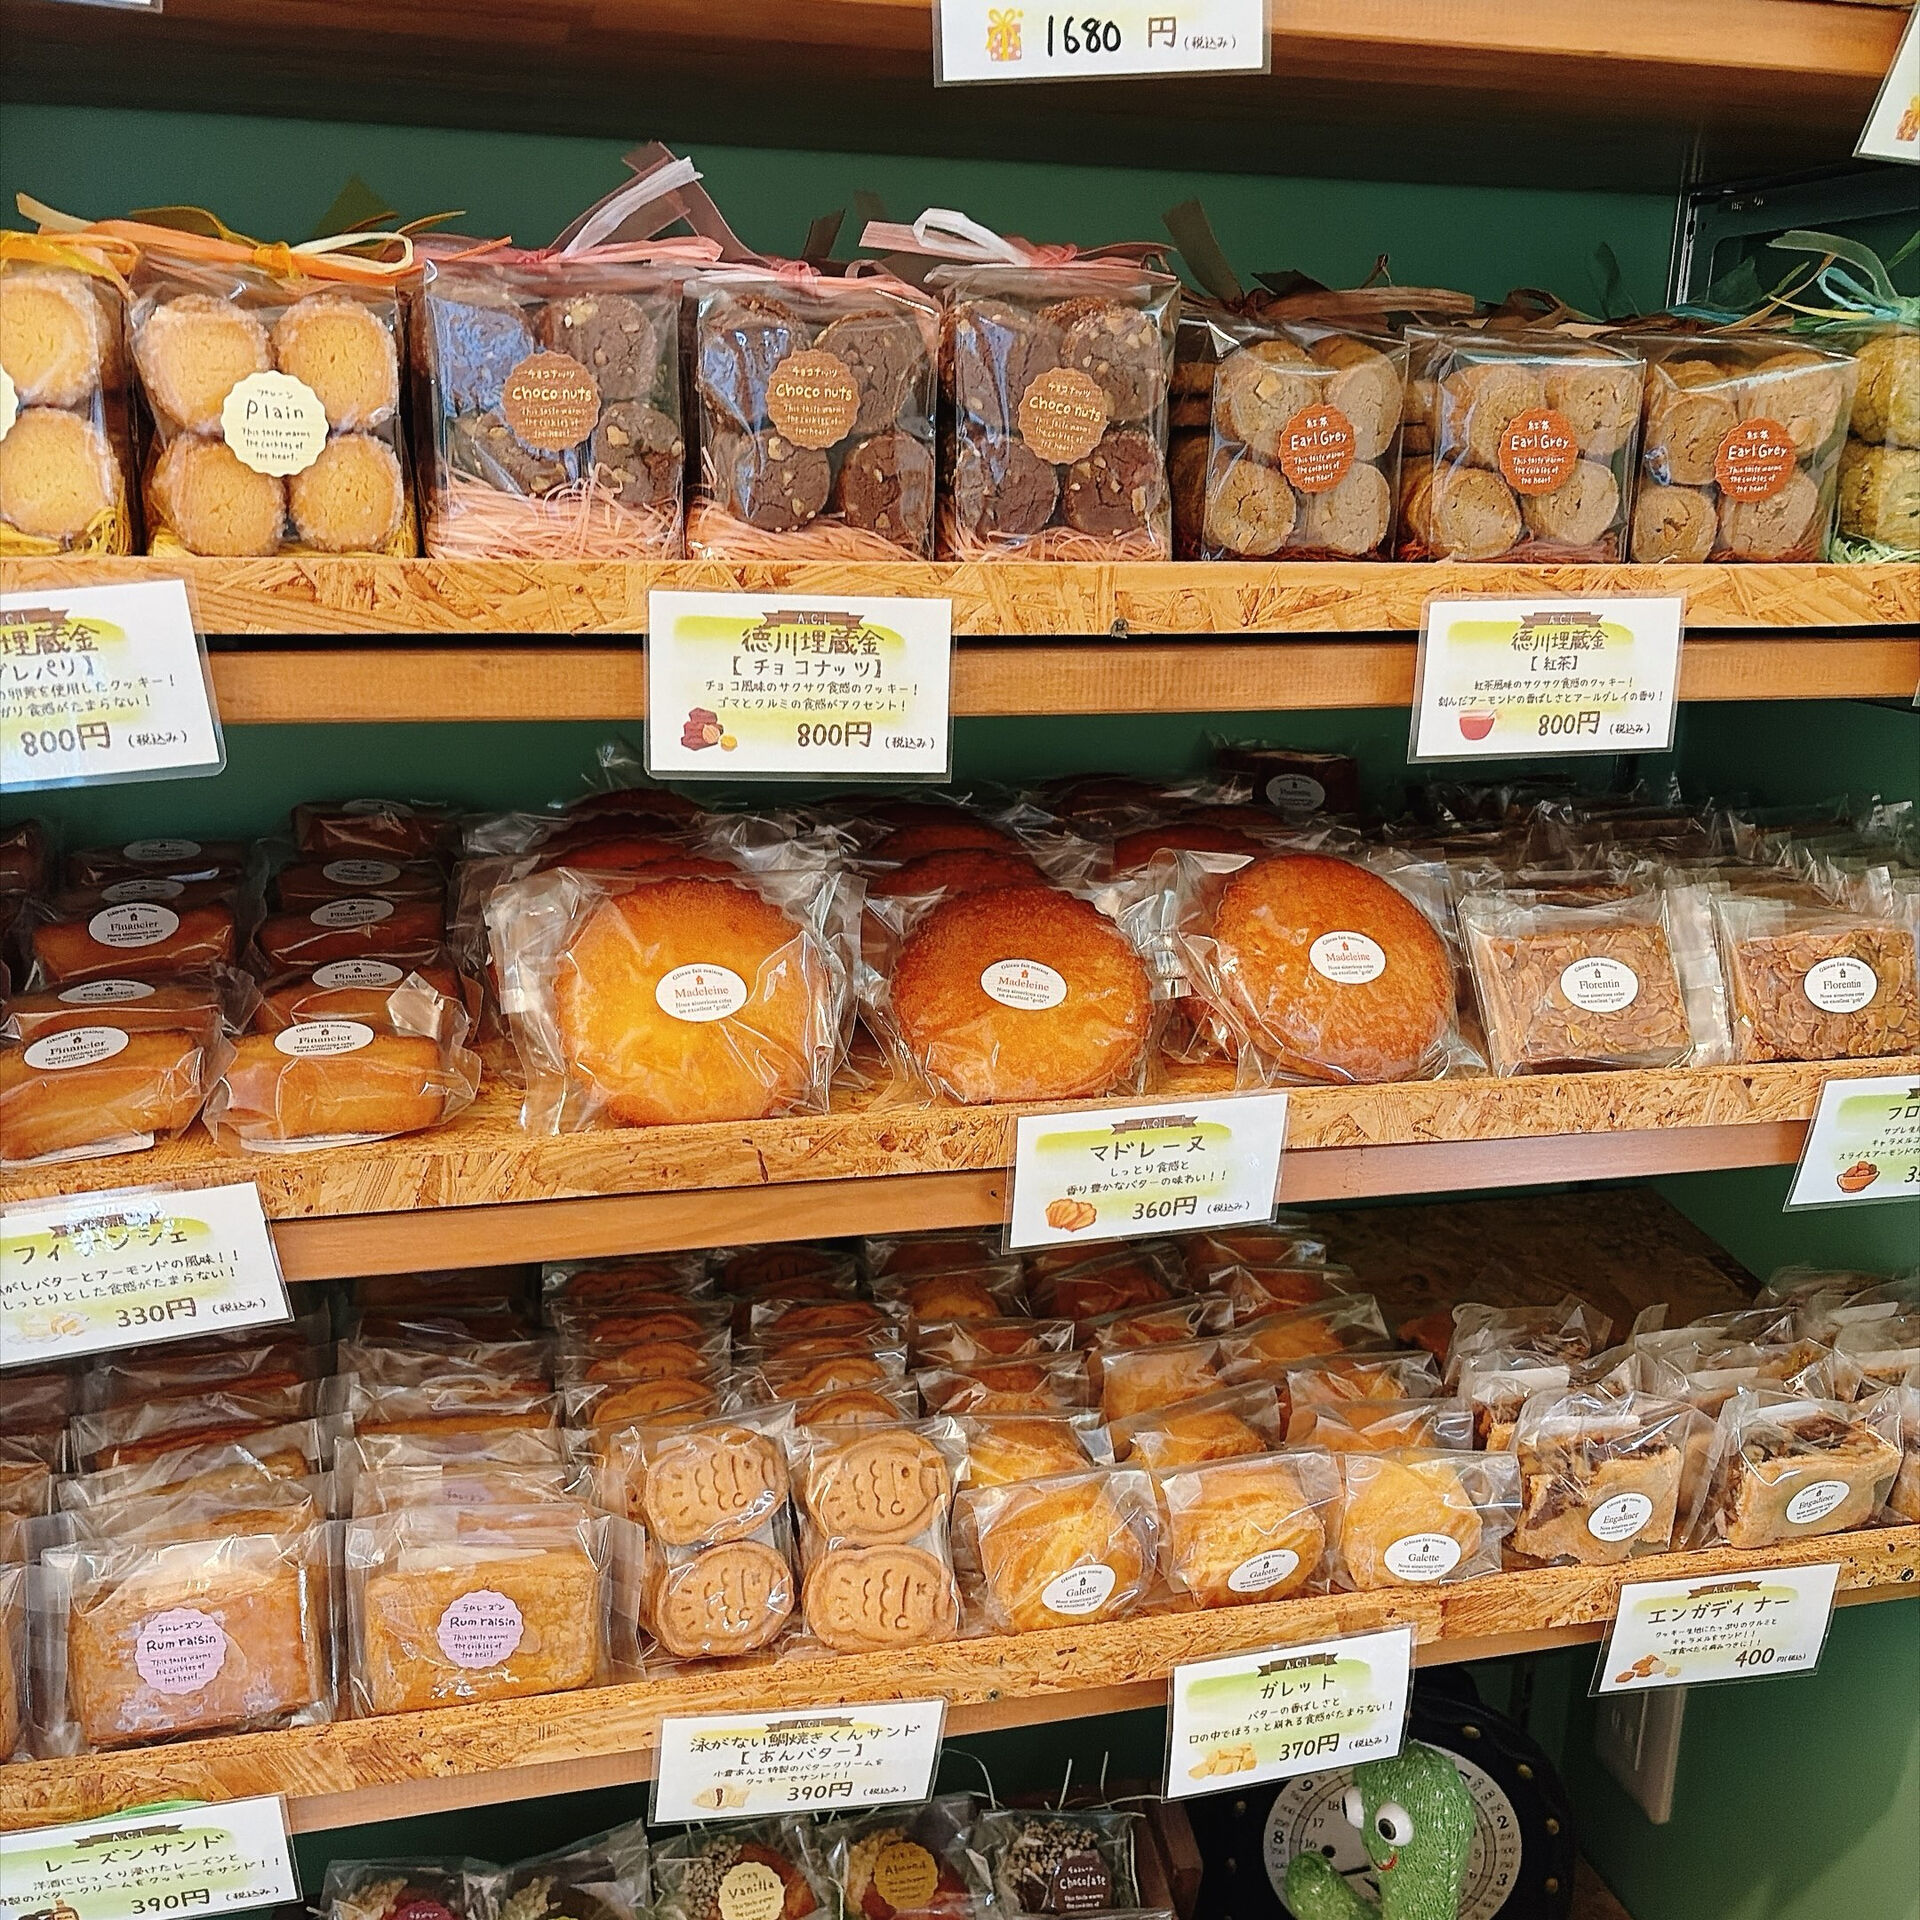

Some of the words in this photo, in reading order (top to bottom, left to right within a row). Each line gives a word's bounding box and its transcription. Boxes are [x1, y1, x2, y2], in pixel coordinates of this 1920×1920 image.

[1048, 15, 1121, 57] 1680
[1147, 16, 1177, 49] 円
[563, 387, 592, 401] nuts
[824, 387, 852, 401] nuts
[247, 400, 304, 419] Plain
[1075, 404, 1101, 422] nuts
[1291, 431, 1317, 450] Earl
[1320, 431, 1346, 445] Grey
[1511, 434, 1537, 450] Earl
[1540, 435, 1569, 449] Grey
[1728, 444, 1755, 460] Earl
[1759, 444, 1787, 458] Grey
[741, 628, 884, 656] 徳川埋蔵金
[1511, 630, 1608, 652] 徳川埋蔵金
[705, 680, 919, 695] チョコ風味のサクサク食感のクッキー！
[717, 698, 906, 711] ゴマとクルミの食感がアクセント！
[1538, 711, 1601, 736] 800円
[20, 722, 111, 757] 800円
[797, 721, 872, 748] 800円
[111, 921, 159, 932] Financier
[1326, 952, 1370, 961] Madeleine
[674, 986, 729, 998] Madeleine
[999, 977, 1049, 991] Madeleine
[1579, 980, 1619, 989] Florentin
[1824, 980, 1861, 989] Florentin
[50, 1040, 106, 1055] Financier
[299, 1035, 352, 1044] Financier
[1090, 1135, 1206, 1162] マドレーヌ
[1110, 1160, 1190, 1178] しっとり食感と
[1132, 1196, 1197, 1220] 360円
[3, 1266, 236, 1311] しっとりとした食感がたまらない！
[116, 1297, 196, 1328] 330円
[1799, 1495, 1835, 1509] Engadiner
[1603, 1512, 1639, 1524] Engadiner
[1408, 1553, 1439, 1562] Galette
[1250, 1568, 1278, 1578] Galette
[1066, 1586, 1096, 1597] Galette
[1648, 1597, 1790, 1624] エンガディナー
[450, 1617, 476, 1627] Rum
[480, 1618, 516, 1626] raisin
[147, 1640, 175, 1652] Rum
[179, 1635, 216, 1646] raisin
[1735, 1649, 1775, 1668] 400
[1260, 1673, 1335, 1700] ガレット
[1248, 1698, 1340, 1720] バターの香ばしさと
[690, 1725, 921, 1753] 泳がない鯛焼きくんサンド
[1279, 1734, 1340, 1761] 370円
[787, 1782, 853, 1801] 390円
[1313, 1818, 1324, 1828] 17
[1497, 1815, 1509, 1829] 2
[1274, 1831, 1284, 1844] 8
[45, 1835, 224, 1874] レーズンサンド
[1060, 1875, 1106, 1889] Chocolate
[1497, 1873, 1507, 1886] 3
[729, 1880, 774, 1899] Vanilla
[130, 1888, 210, 1915] 390円
